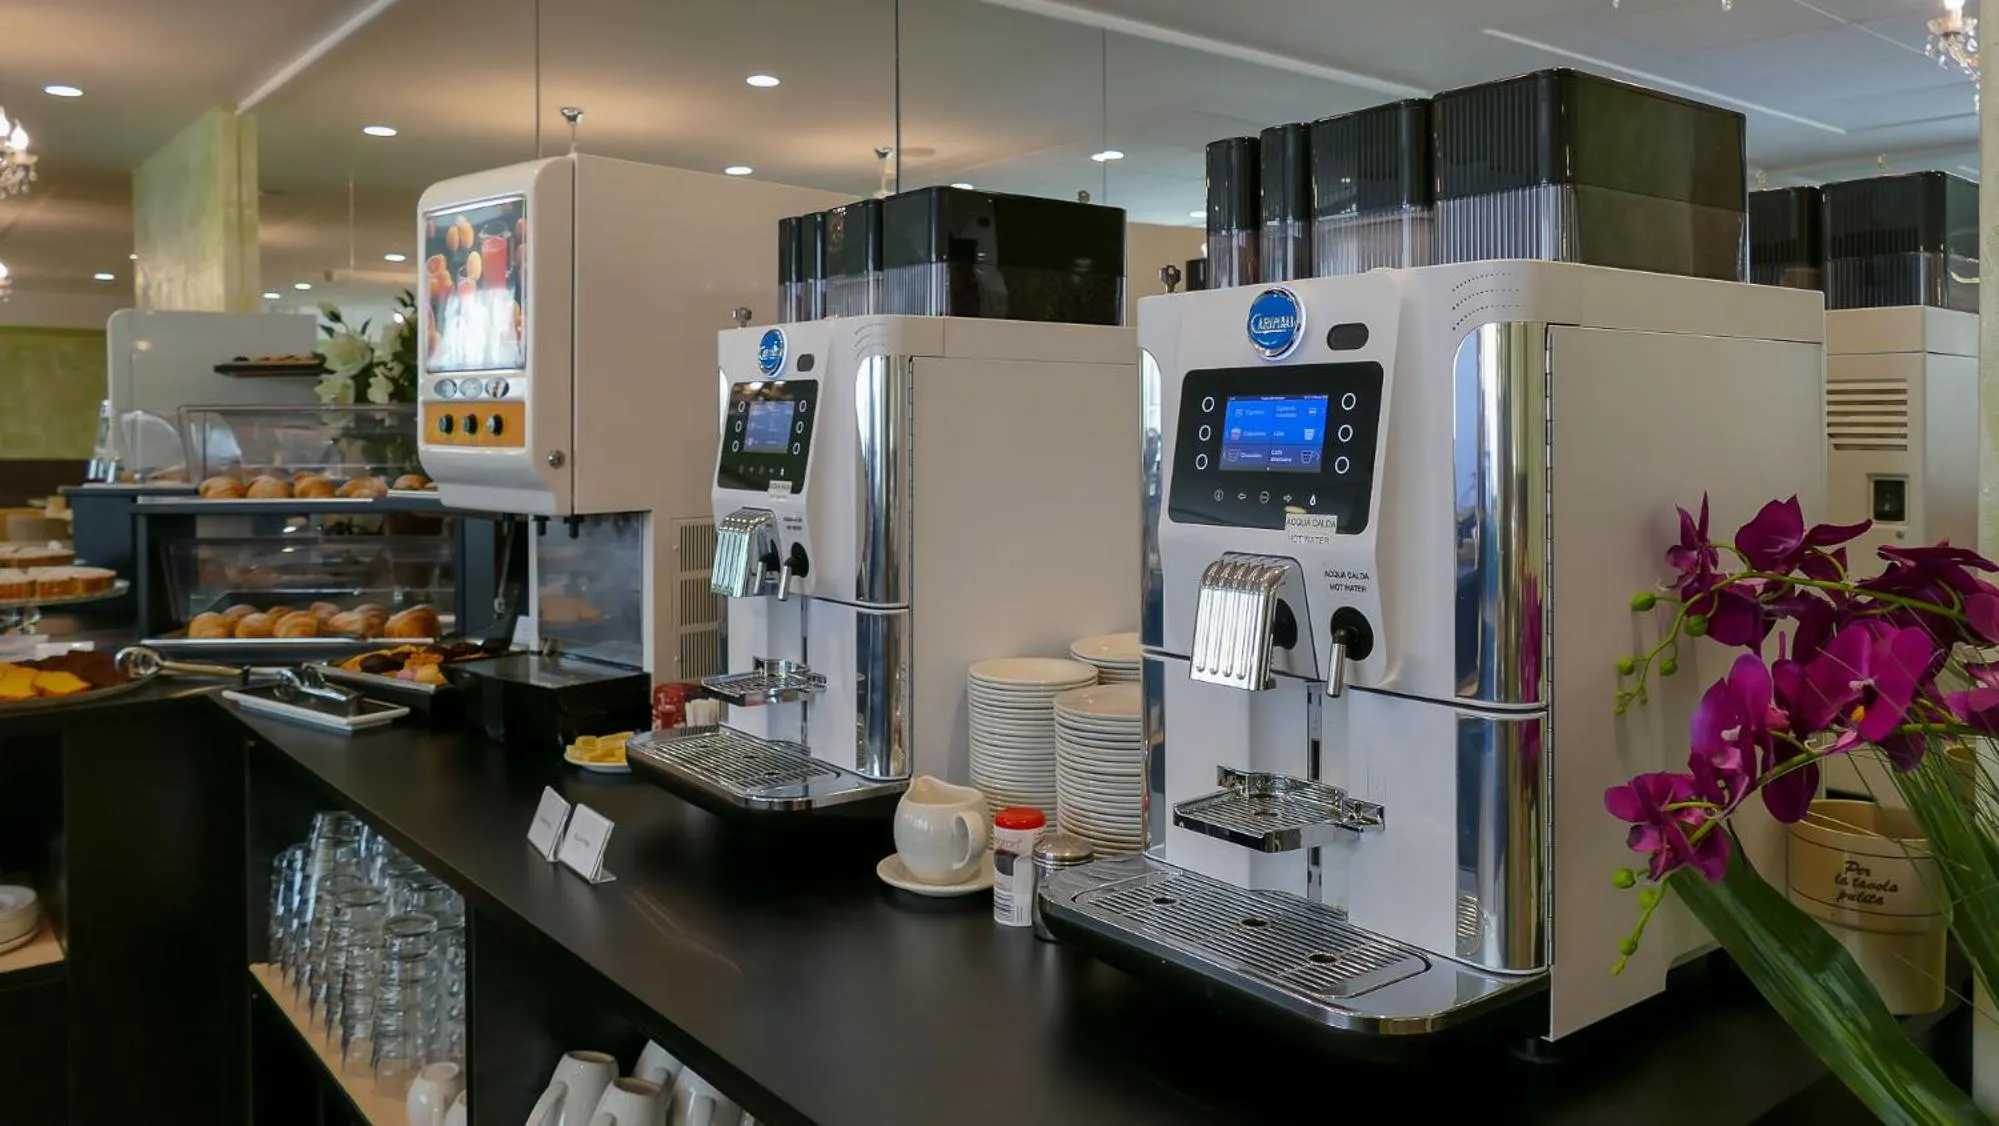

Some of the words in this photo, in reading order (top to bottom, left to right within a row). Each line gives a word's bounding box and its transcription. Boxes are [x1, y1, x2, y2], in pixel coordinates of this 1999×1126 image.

[1311, 518, 1336, 528] CALDA
[1324, 569, 1346, 579] ACQUA
[1347, 571, 1369, 580] CALDA
[1329, 583, 1343, 592] HOT
[1344, 584, 1367, 593] WATER
